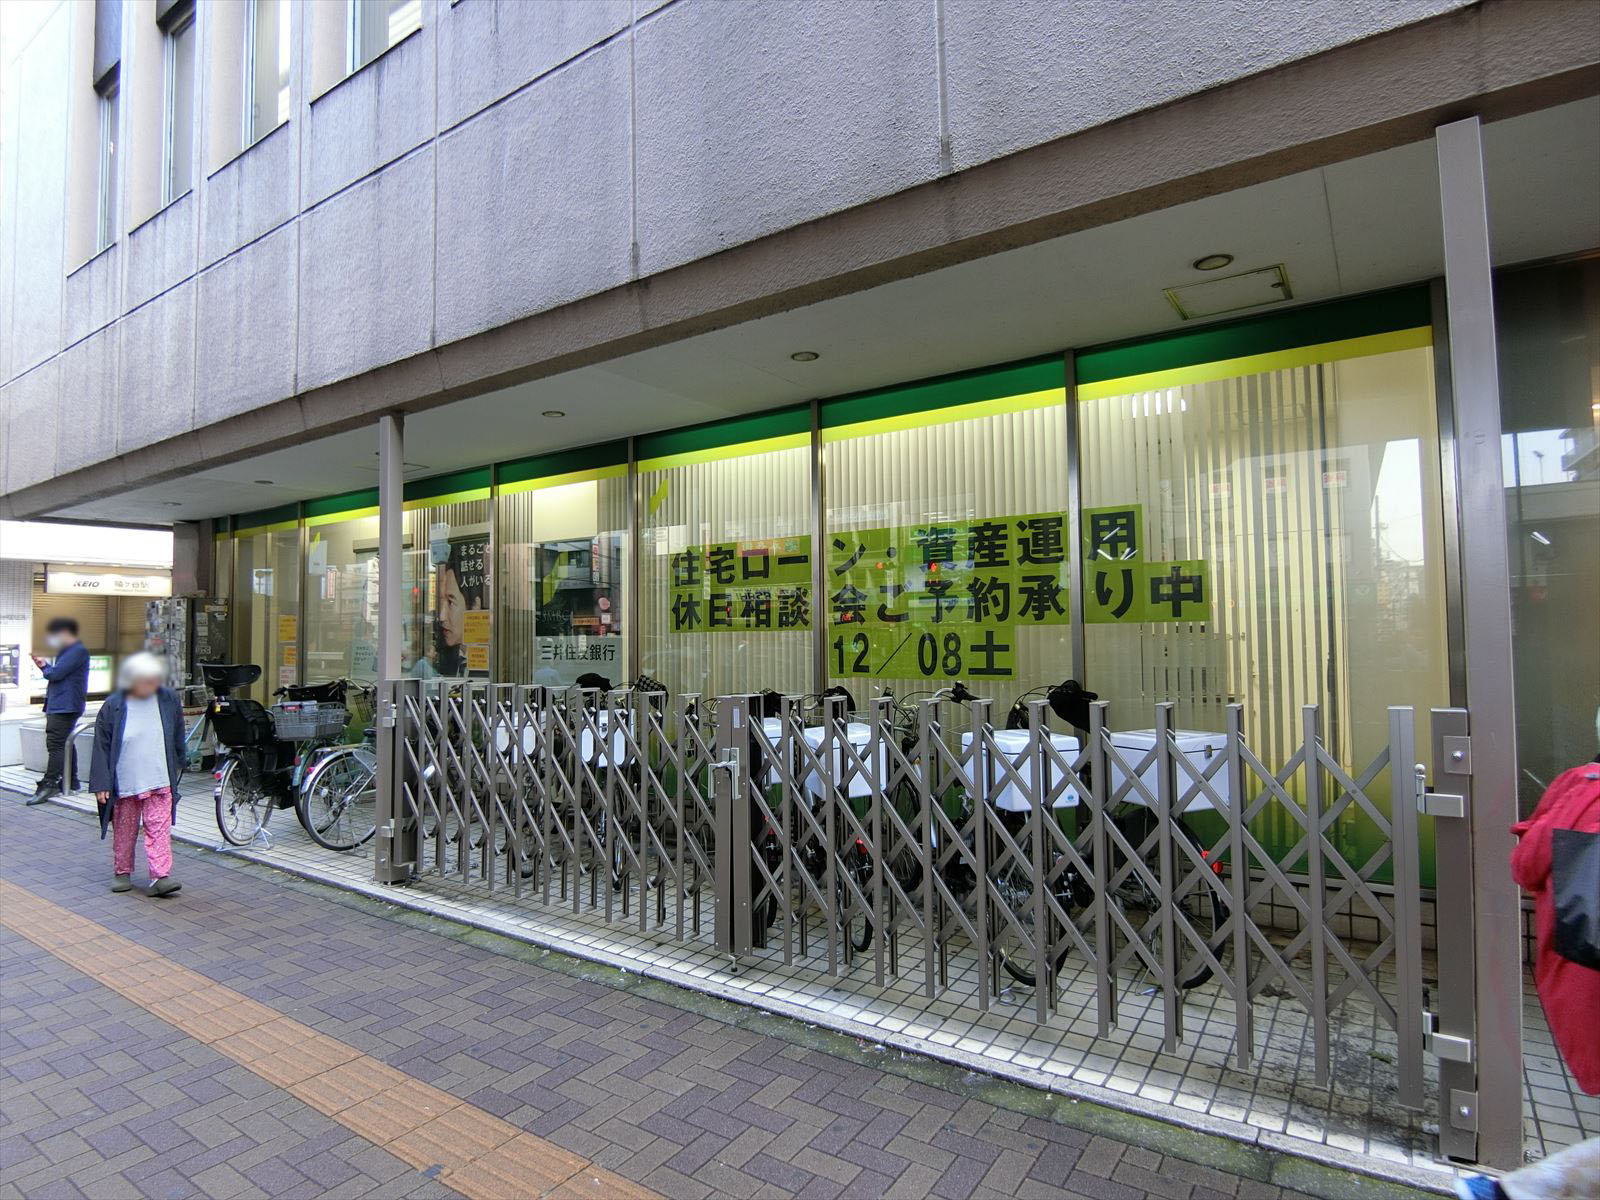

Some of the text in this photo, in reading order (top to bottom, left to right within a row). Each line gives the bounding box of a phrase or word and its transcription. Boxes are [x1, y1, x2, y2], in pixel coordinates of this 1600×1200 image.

[461, 542, 490, 556] まるごと
[73, 580, 100, 588] KEIO
[461, 575, 490, 588] 人がいる
[672, 566, 1203, 630] 休日相談会ご予約承り中
